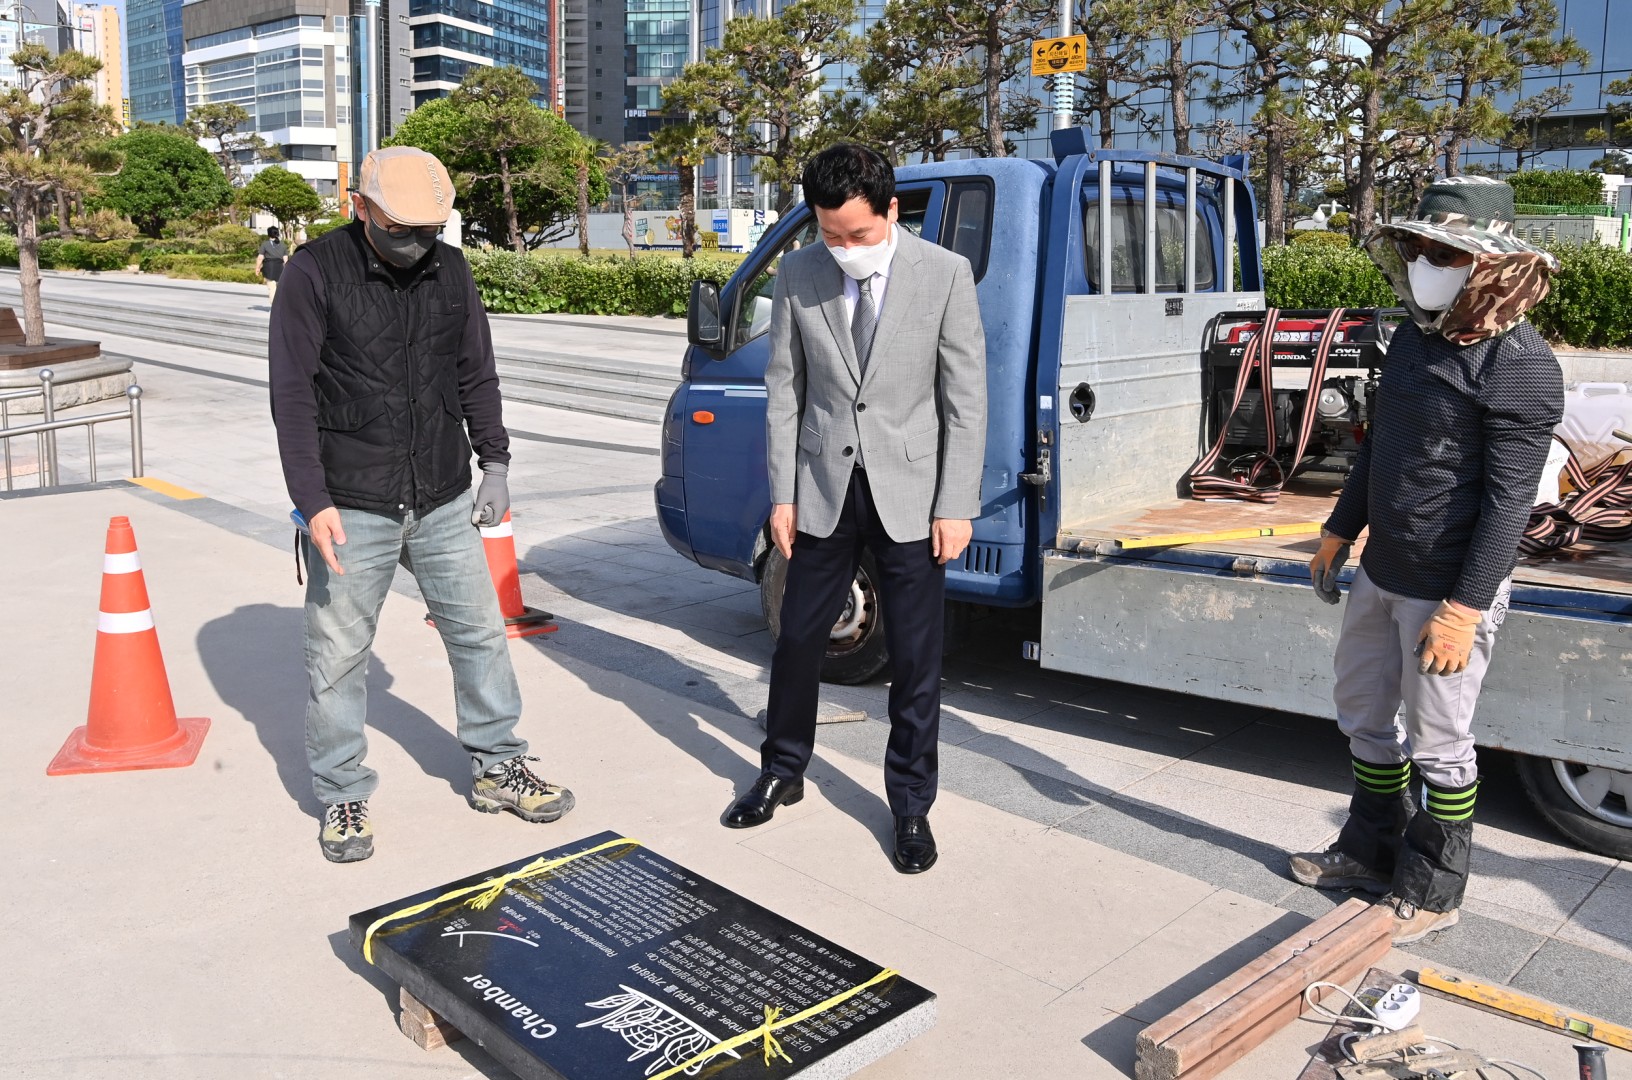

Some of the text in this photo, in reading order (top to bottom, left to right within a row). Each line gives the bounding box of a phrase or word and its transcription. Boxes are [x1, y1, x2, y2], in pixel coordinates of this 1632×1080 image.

[598, 873, 616, 881] We
[627, 872, 646, 881] with
[502, 887, 518, 895] the
[594, 886, 610, 894] sea
[608, 879, 631, 890] 2020.
[640, 879, 672, 895] inscribed
[652, 878, 680, 891] cultural
[539, 890, 564, 903] master
[576, 885, 613, 905] demolished
[604, 892, 621, 901] and
[624, 887, 654, 902] October
[635, 885, 662, 898] without
[679, 892, 699, 901] trust
[557, 901, 573, 909] the
[615, 898, 645, 914] typhoon
[634, 900, 652, 909] was
[656, 896, 692, 914] demolition
[673, 896, 697, 908] stone
[693, 898, 721, 912] storing
[567, 907, 591, 920] where
[652, 902, 681, 917] Square
[685, 912, 702, 920] the
[690, 906, 710, 916] This
[556, 920, 575, 930] the
[585, 917, 608, 929] place
[598, 916, 625, 930] Dennis
[621, 920, 643, 932] used
[600, 927, 617, 935] the
[567, 926, 620, 957] Remembering
[616, 937, 635, 947] This
[744, 943, 769, 955] 깊이
[773, 946, 791, 954] 이
[653, 944, 699, 969] 자리입니다.
[723, 957, 752, 972] 그대로
[626, 962, 669, 986] 기억하며
[690, 966, 715, 979] 있던
[742, 981, 774, 998] 태풍과
[760, 978, 786, 991] 10월
[810, 978, 836, 991] 없이
[660, 983, 700, 1006] 내부)를
[705, 989, 738, 1006] 데니스
[766, 968, 868, 1022] 광장에 설치하였습니다.
[778, 987, 813, 1006] 2020년
[457, 971, 561, 1040] Chamber
[691, 1002, 720, 1018] 꽃의
[730, 1003, 755, 1017] 거장
[766, 995, 801, 1014] 2017년
[846, 997, 881, 1015] 충분한
[780, 1032, 815, 1052] 이곳은
